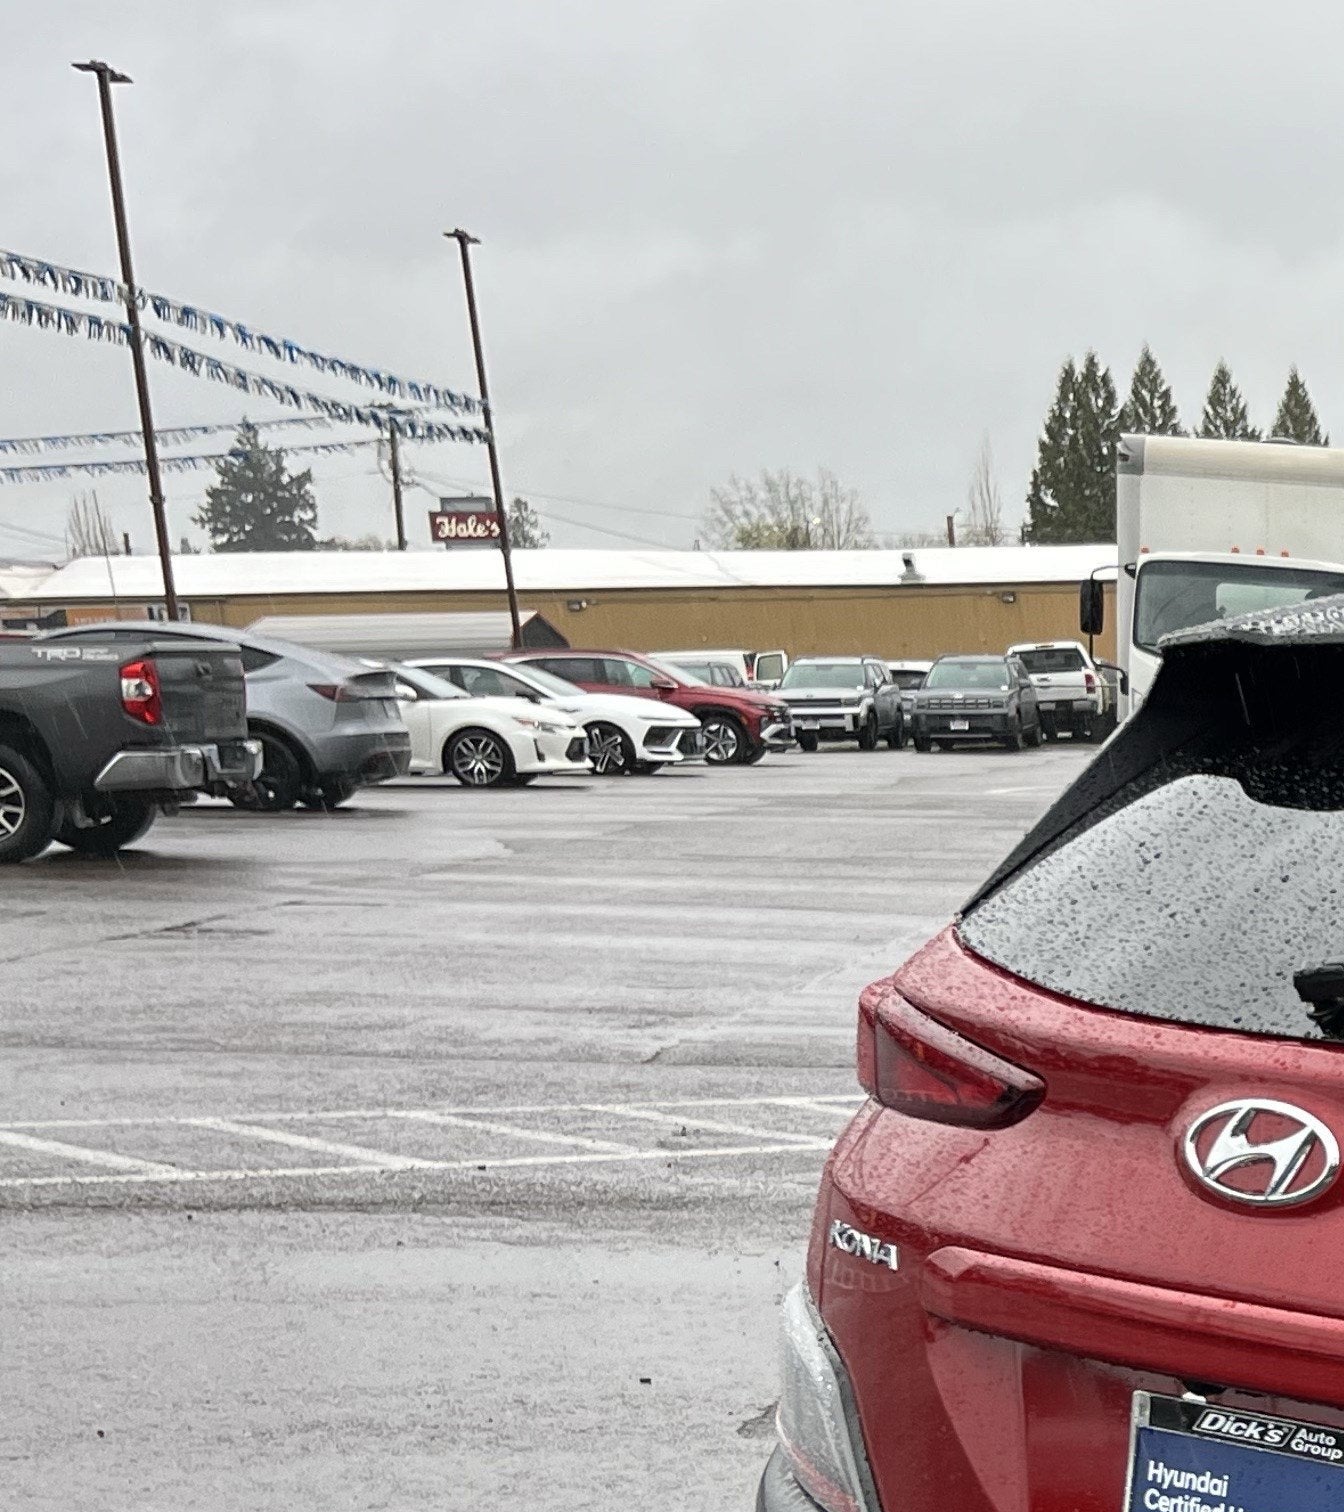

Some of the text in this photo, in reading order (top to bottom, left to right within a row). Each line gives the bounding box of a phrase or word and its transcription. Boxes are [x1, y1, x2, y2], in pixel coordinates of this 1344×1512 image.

[436, 515, 501, 538] Hale's
[829, 1218, 899, 1271] KONA
[1199, 1410, 1287, 1446] Dick's
[1296, 1428, 1337, 1447] Auto
[1290, 1440, 1344, 1462] Group
[1147, 1459, 1229, 1498] Hyundai
